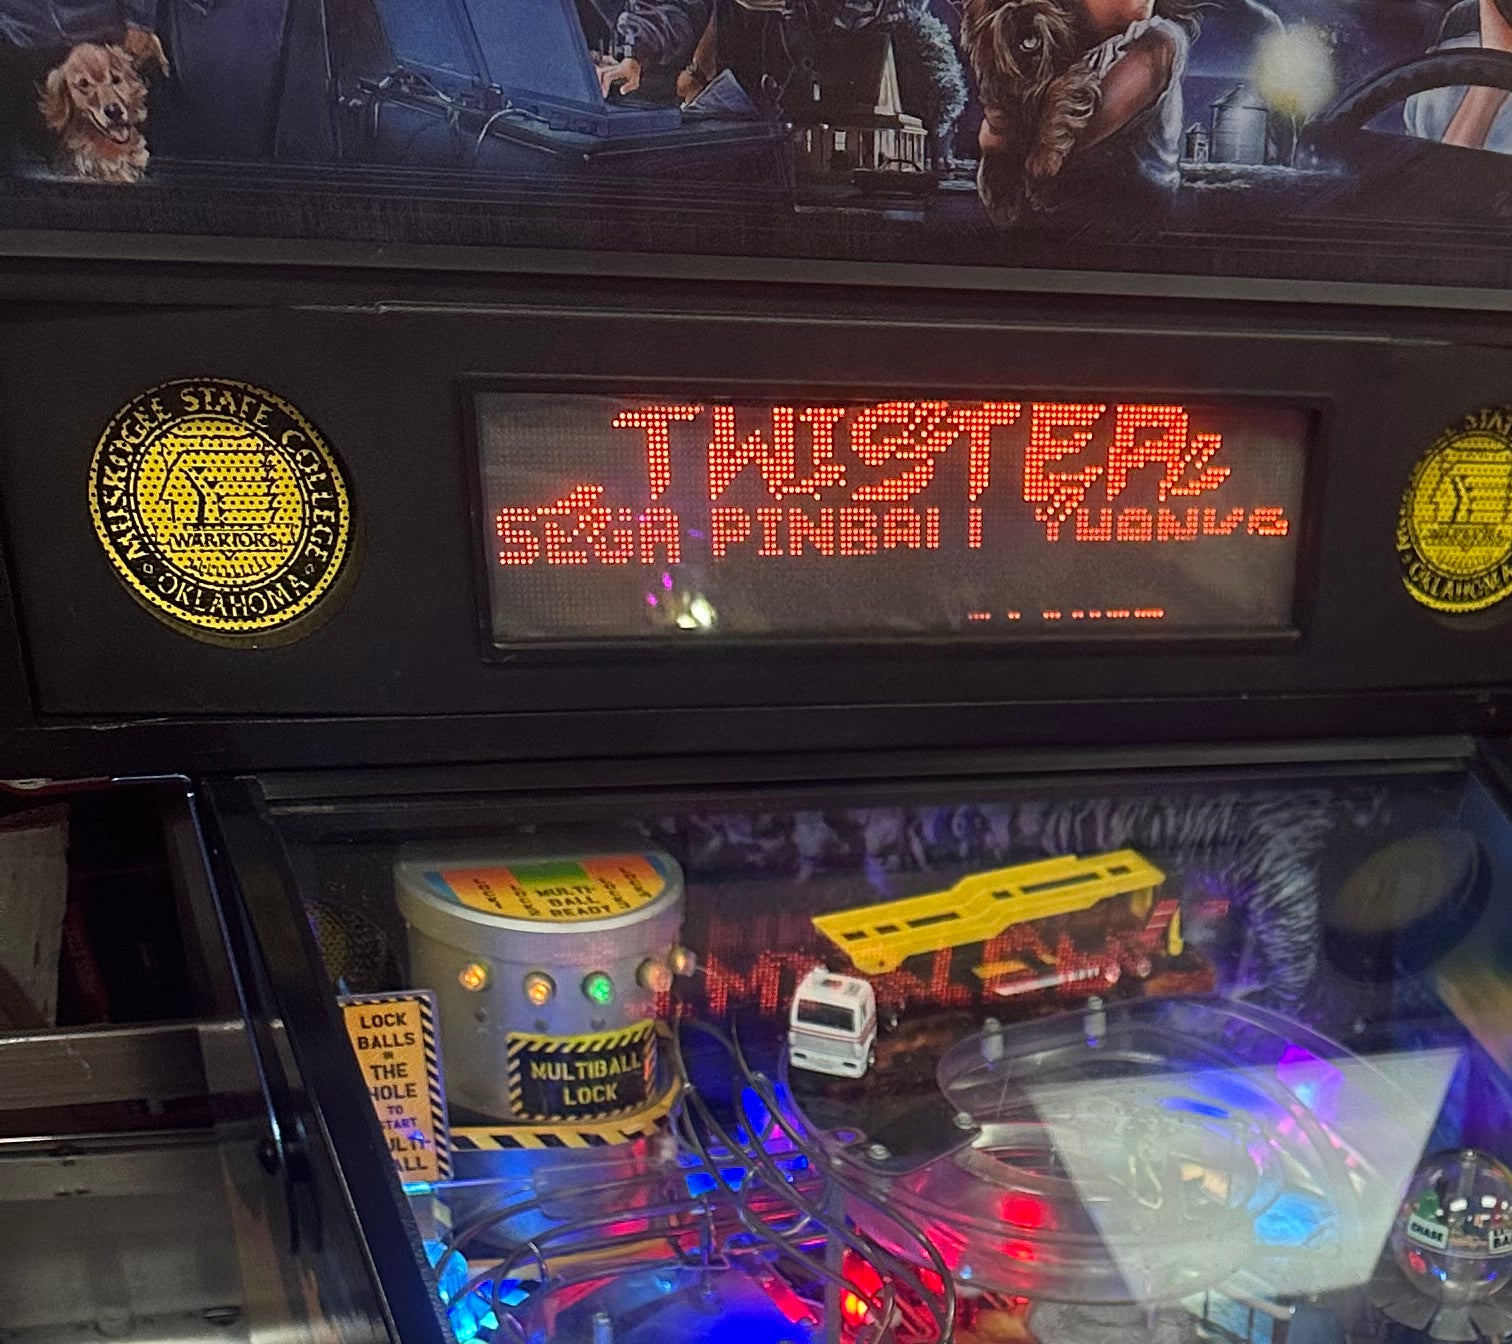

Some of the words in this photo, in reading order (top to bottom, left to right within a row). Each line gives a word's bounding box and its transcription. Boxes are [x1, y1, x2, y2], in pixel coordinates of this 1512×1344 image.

[101, 396, 172, 561] MUSKOGEE
[180, 387, 273, 428] STATE
[281, 429, 336, 563] COLLEGE
[157, 572, 310, 618] OKLAHOMA
[359, 1012, 407, 1029] LOCK
[358, 1032, 415, 1050] BALLS
[370, 1062, 410, 1080] THE
[530, 1051, 641, 1081] MULTIBALL
[563, 1083, 619, 1106] LOCK
[386, 1105, 404, 1117] TO
[1410, 1222, 1443, 1243] CHASE
